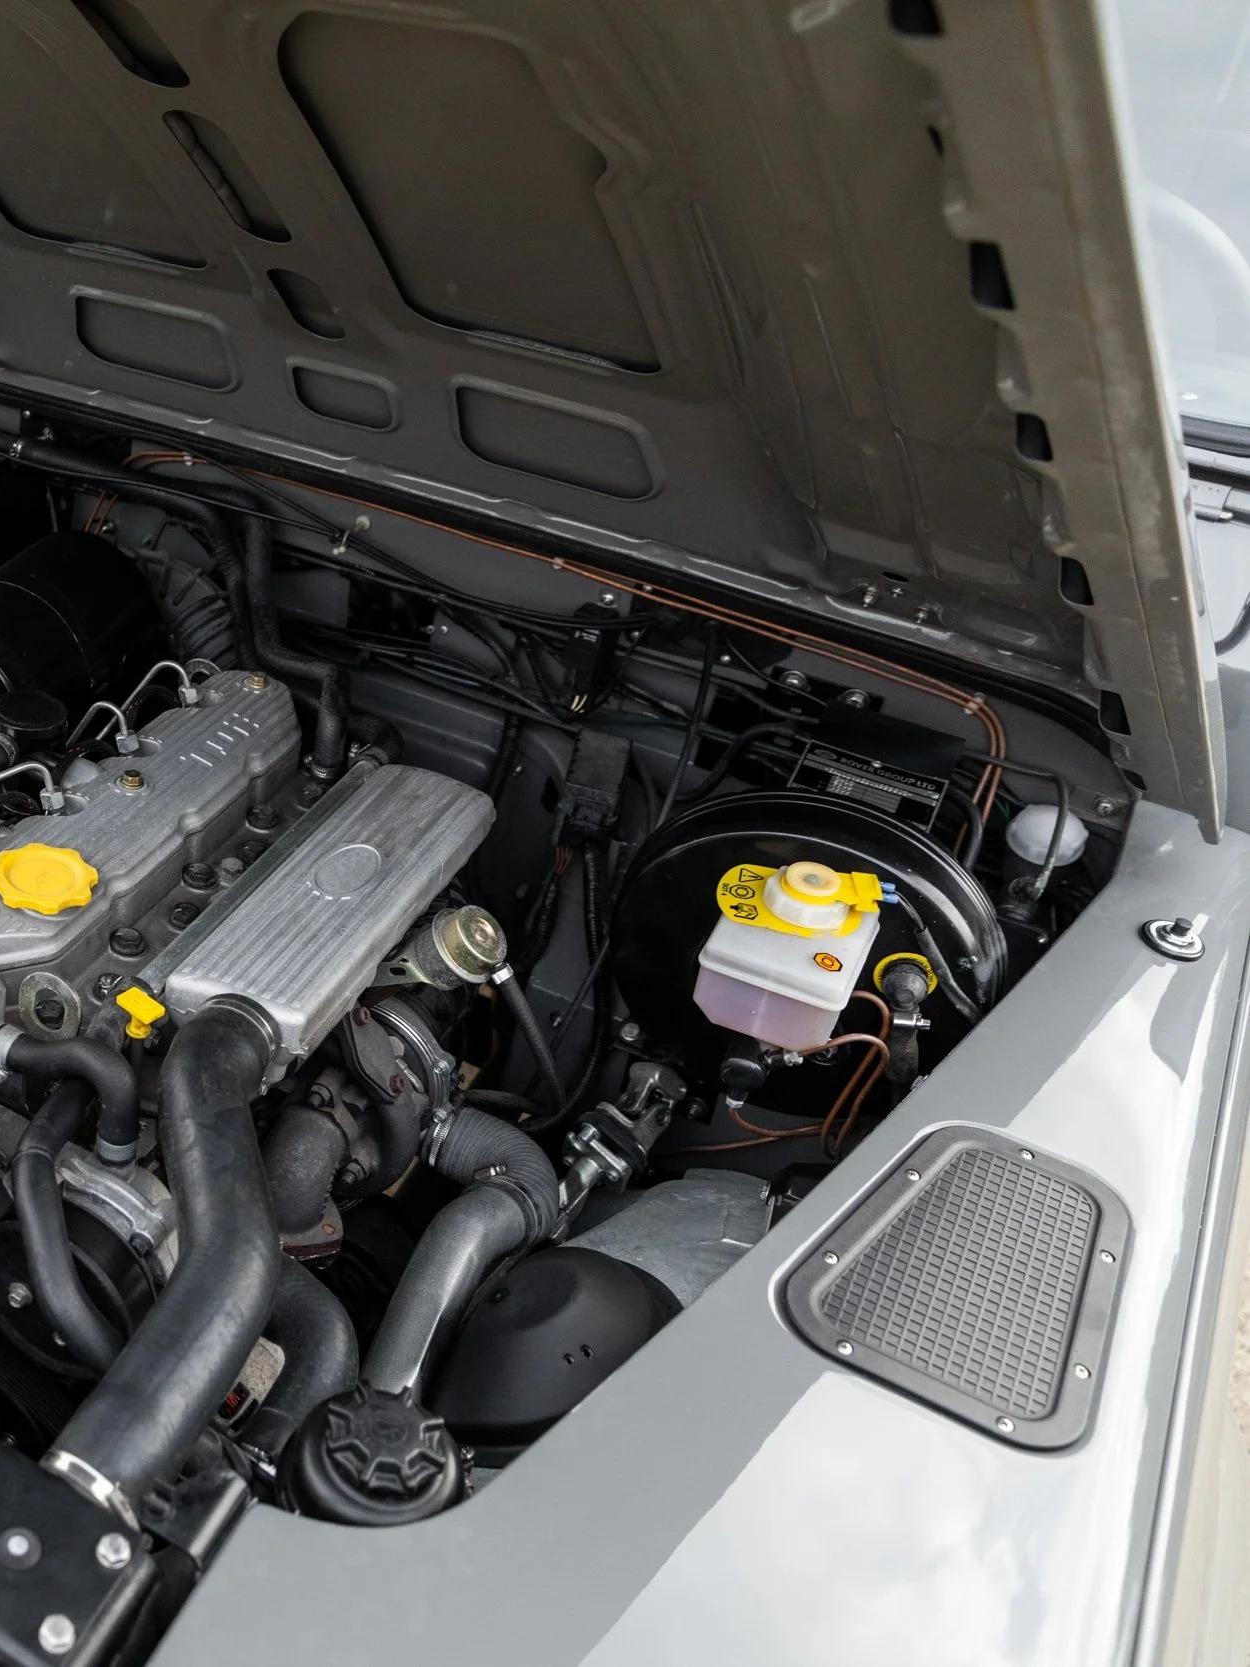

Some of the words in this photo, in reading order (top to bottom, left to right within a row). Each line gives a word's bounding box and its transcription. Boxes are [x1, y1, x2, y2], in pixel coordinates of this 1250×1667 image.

[839, 757, 875, 774] ROVER
[876, 768, 916, 785] GROUP
[915, 781, 936, 791] LTD
